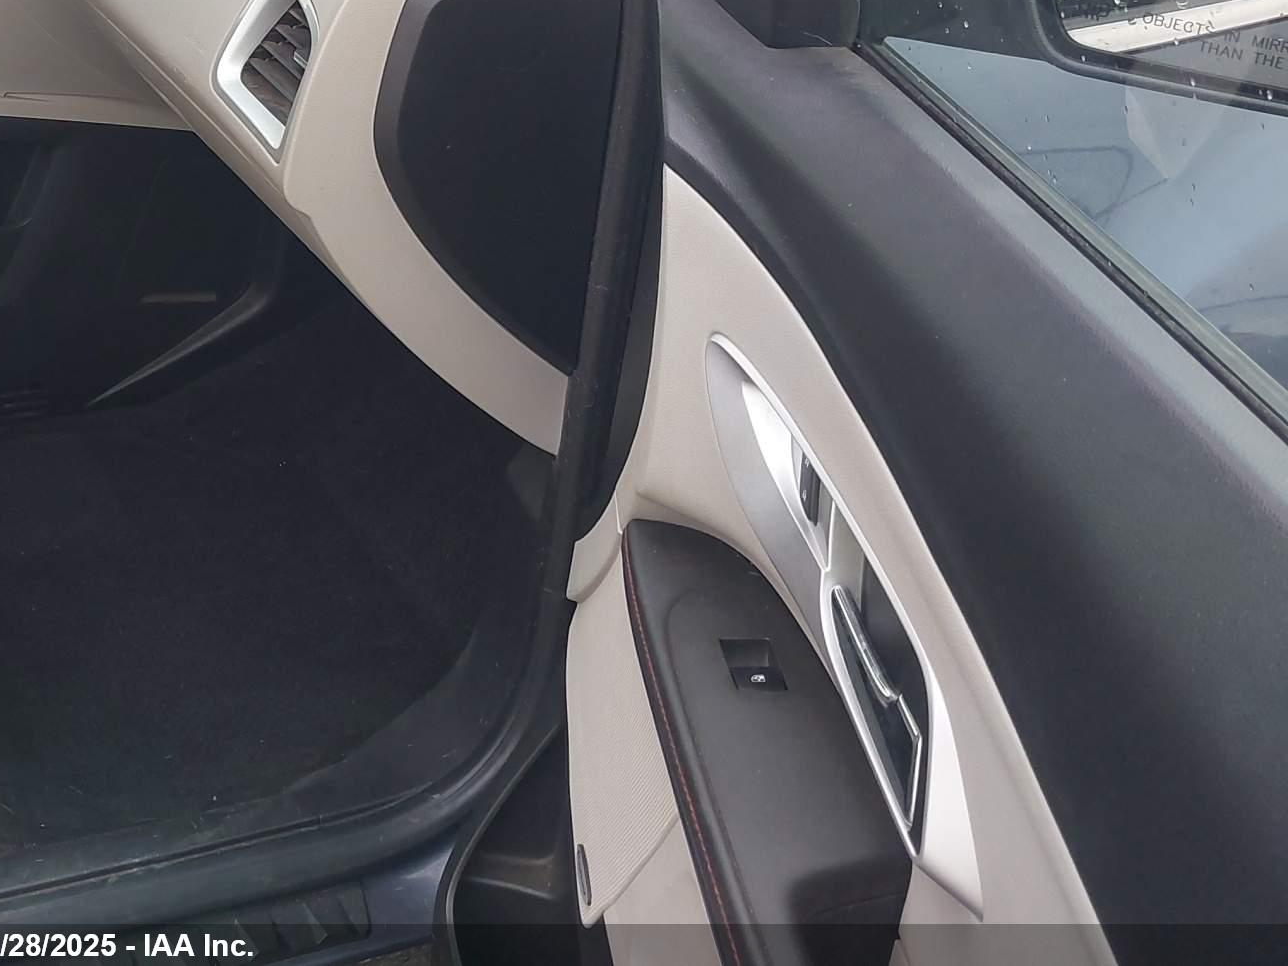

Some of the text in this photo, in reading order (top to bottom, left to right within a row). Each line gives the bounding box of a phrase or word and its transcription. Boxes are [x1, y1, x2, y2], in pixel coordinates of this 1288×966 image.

[1223, 30, 1241, 43] IN
[1200, 40, 1286, 70] THAN THE
